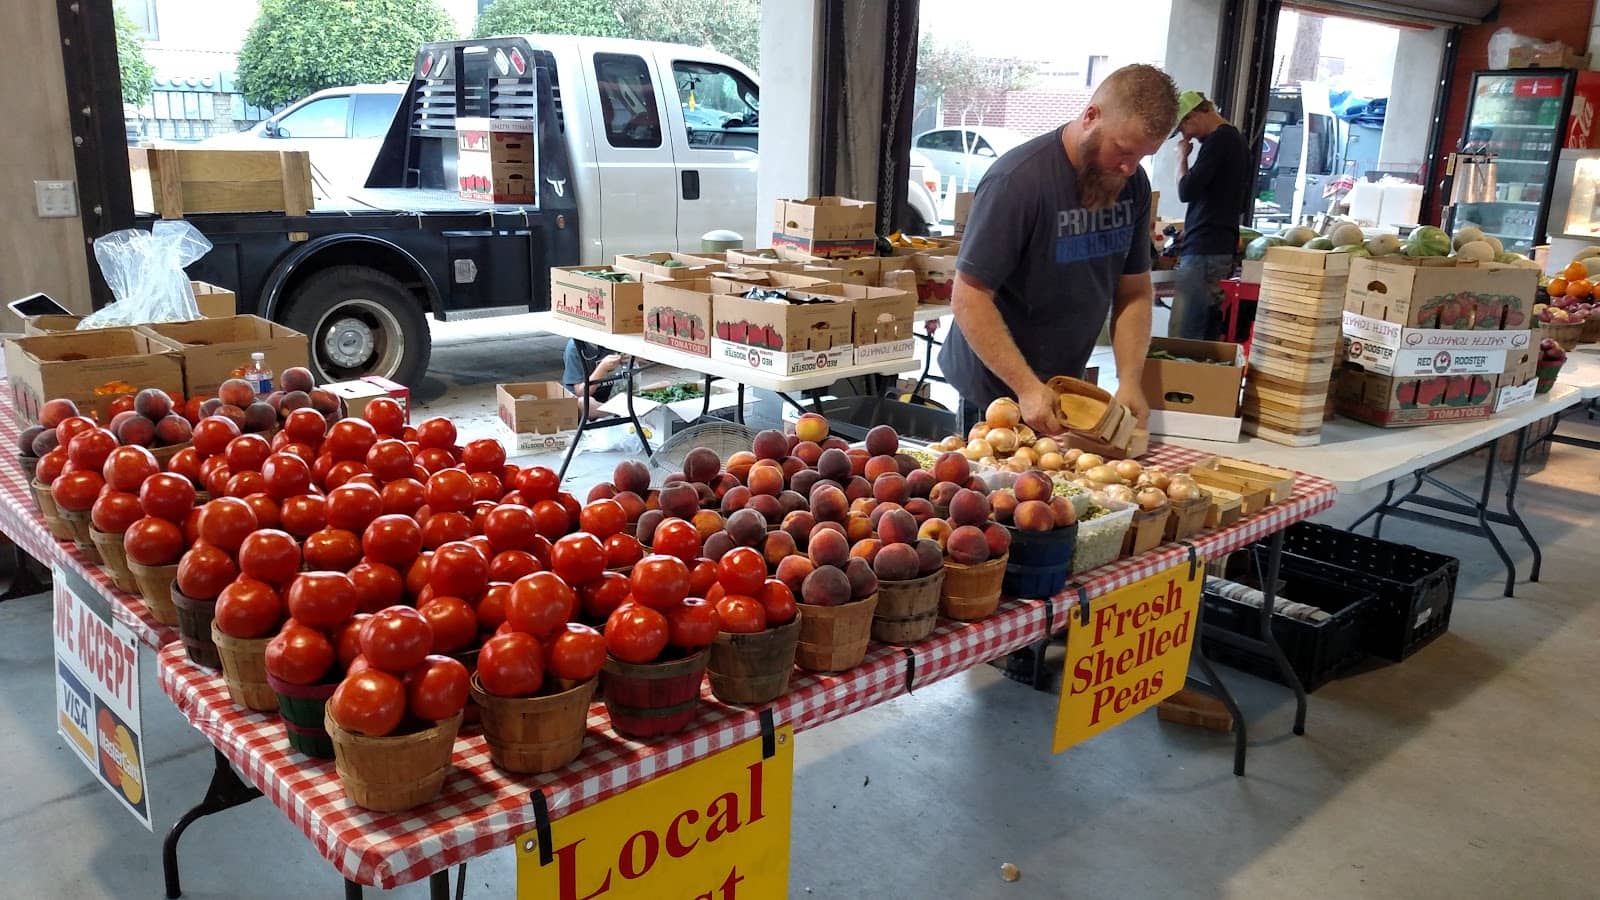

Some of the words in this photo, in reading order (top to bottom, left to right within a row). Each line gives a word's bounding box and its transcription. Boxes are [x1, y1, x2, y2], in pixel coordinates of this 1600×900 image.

[1057, 198, 1134, 237] PROTECT
[1373, 323, 1399, 338] SMITH
[670, 337, 706, 354] TOMATOES
[1428, 335, 1469, 346] TOMATO
[1471, 336, 1507, 346] SMITH
[724, 349, 747, 361] ROOSTER
[1363, 343, 1393, 358] ROOSTER
[761, 357, 773, 367] RED
[791, 362, 817, 373] ROOSTER
[827, 359, 838, 367] RED
[1417, 356, 1432, 367] RED
[1454, 355, 1486, 367] ROOSTER
[1432, 407, 1486, 419] TOMATOES
[1091, 579, 1183, 648] Fresh
[55, 581, 74, 651] WE
[78, 603, 135, 711] ACCEPT
[1070, 610, 1191, 696] Shelled
[1088, 670, 1164, 728] Peas
[63, 684, 89, 736] VISA
[99, 727, 141, 785] MasterCard
[552, 761, 766, 900] Local
